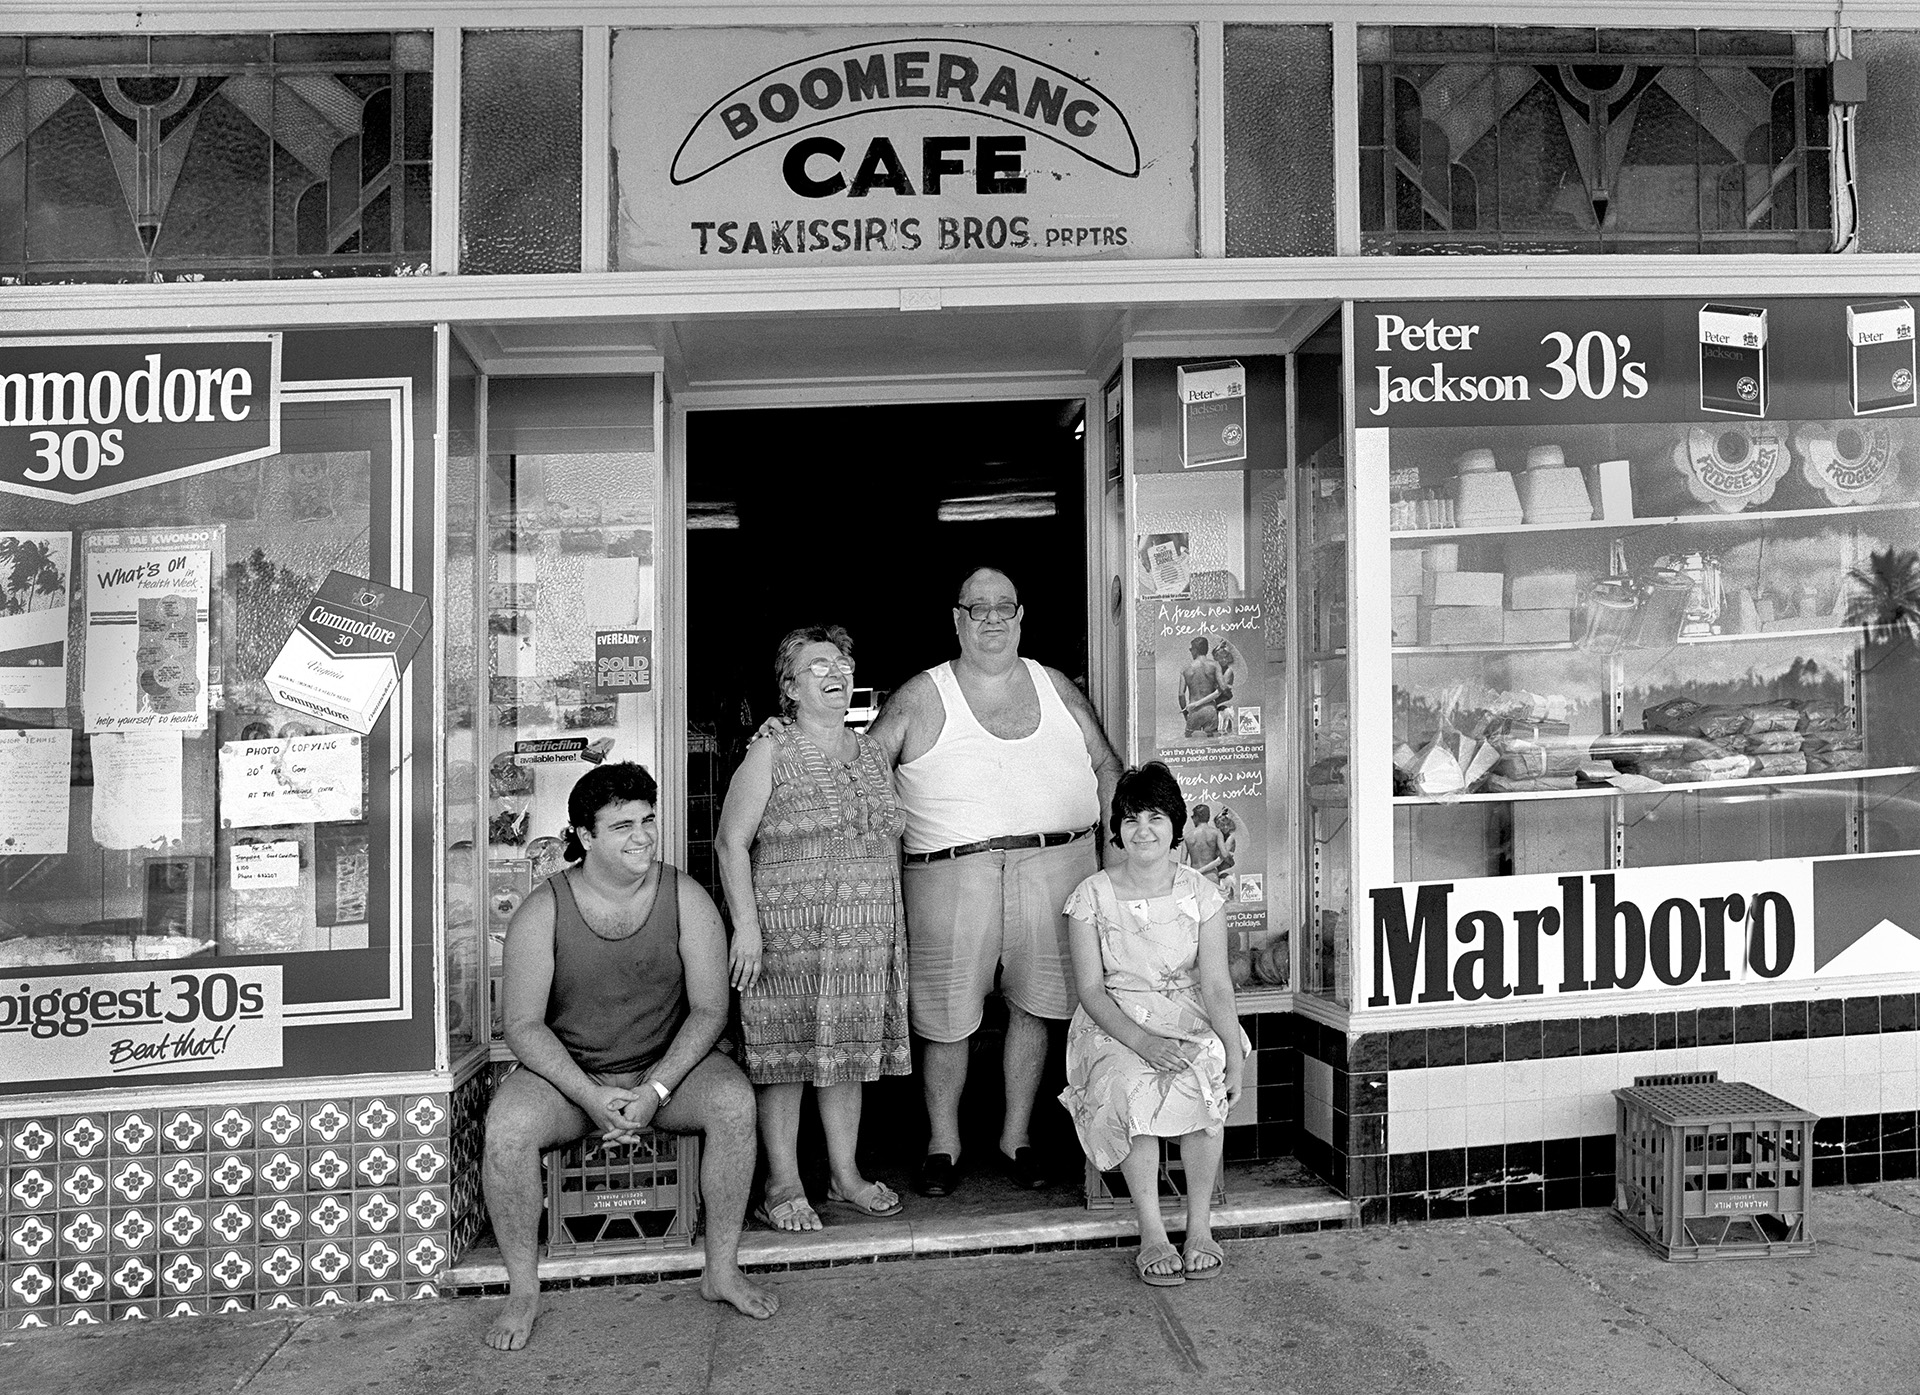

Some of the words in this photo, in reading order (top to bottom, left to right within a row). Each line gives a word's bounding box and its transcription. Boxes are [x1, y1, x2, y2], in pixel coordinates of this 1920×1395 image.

[719, 51, 1100, 141] BOOMERANG
[782, 134, 1027, 198] CAFE
[1374, 314, 1480, 351] Peter
[1705, 331, 1731, 344] Peter
[1858, 331, 1884, 344] Peter
[1703, 345, 1743, 360] Jackson
[1369, 362, 1531, 416] Jackson
[1539, 330, 1649, 401] 30's
[0, 353, 253, 427] mmodore
[1188, 390, 1215, 401] Peter
[1742, 383, 1753, 393] 30
[1189, 402, 1228, 417] Jackson
[1227, 430, 1238, 440] 30
[22, 428, 125, 482] 30s
[128, 535, 149, 545] TAE
[97, 561, 161, 589] What's
[167, 555, 187, 573] on
[137, 578, 170, 589] Health
[171, 577, 198, 589] Week
[1158, 603, 1170, 621] A
[1172, 602, 1207, 624] fresh
[1207, 604, 1232, 618] new
[1235, 603, 1261, 619] way
[309, 605, 397, 645] Commodore
[1160, 622, 1174, 637] to
[1176, 625, 1196, 636] see
[1197, 621, 1219, 636] the
[334, 633, 353, 647] 30
[597, 631, 640, 646] EVEREADY
[598, 656, 650, 672] SOLD
[597, 671, 650, 687] HERE
[279, 689, 350, 722] Commodore
[95, 714, 115, 727] help
[117, 714, 156, 728] yourself
[158, 715, 169, 724] to
[169, 714, 199, 724] health
[245, 745, 280, 757] PHOTO
[291, 740, 337, 753] COPYING
[518, 740, 583, 752] Pacificfilm
[1159, 748, 1174, 757] Join
[1174, 748, 1184, 756] the
[1185, 746, 1205, 757] Alpine
[1206, 745, 1235, 755] Travellers
[1235, 744, 1251, 754] Club
[1251, 744, 1264, 753] and
[519, 753, 554, 764] available
[555, 753, 577, 763] here!
[1186, 754, 1208, 764] packet
[1218, 754, 1232, 763] your
[1209, 771, 1234, 785] new
[1236, 769, 1262, 785] way
[263, 790, 275, 798] THE
[1182, 790, 1197, 803] ee
[1199, 788, 1221, 804] the
[1237, 912, 1252, 921] Club
[1253, 911, 1266, 920] and
[1368, 873, 1796, 1007] Marlboro
[164, 972, 264, 1025] 30s
[109, 1032, 170, 1065] Beat
[170, 1023, 236, 1060] that!
[613, 1198, 647, 1207] MALANDA
[1714, 1201, 1732, 1209] MILK
[1734, 1200, 1769, 1209] MALANDA
